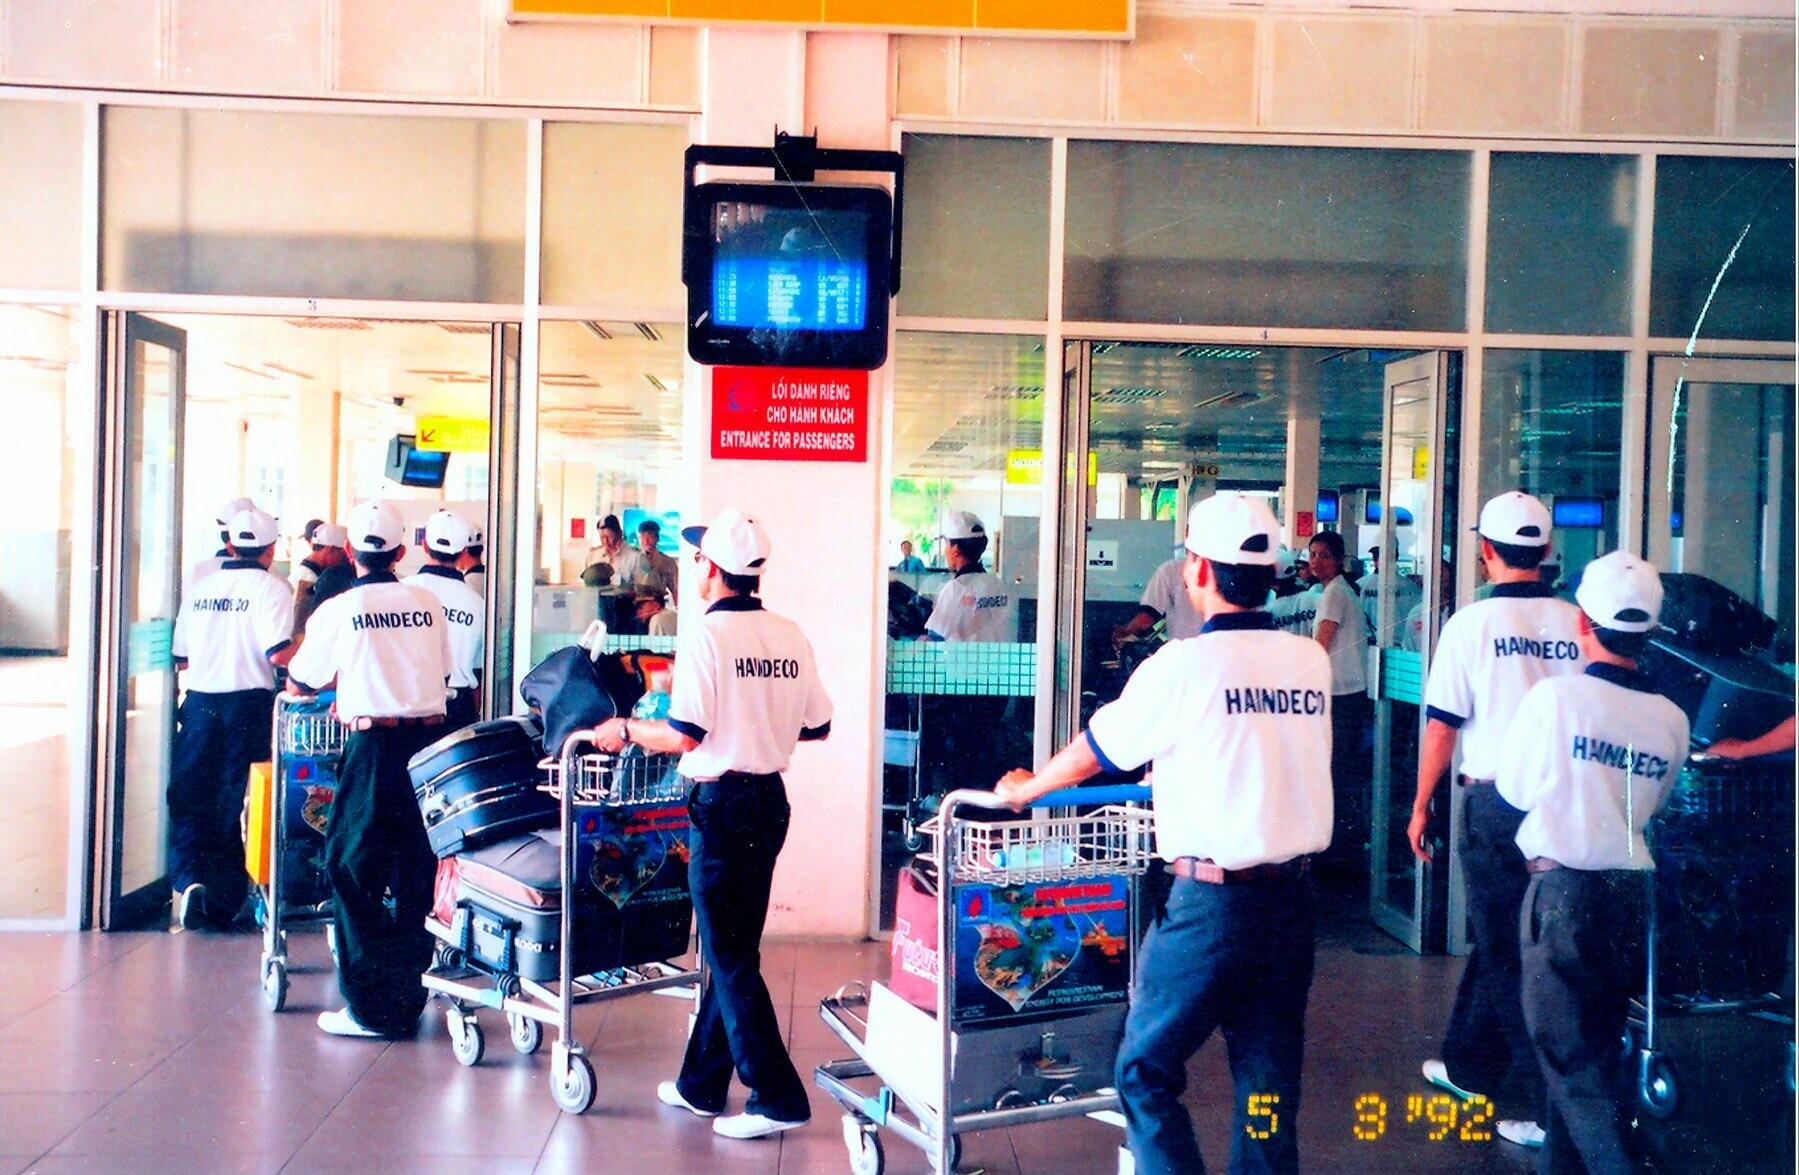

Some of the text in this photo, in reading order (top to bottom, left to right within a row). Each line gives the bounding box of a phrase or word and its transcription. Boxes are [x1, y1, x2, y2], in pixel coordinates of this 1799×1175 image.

[767, 405, 787, 423] CHO
[720, 430, 855, 450] ENTRANCE FOR PASSENGERS
[352, 611, 433, 631] HAINDECO
[1273, 610, 1317, 628] HAINDEC
[1494, 636, 1578, 660] HAINDECO
[1225, 687, 1325, 715] HAINDECO
[1573, 735, 1668, 780] HAINDECO
